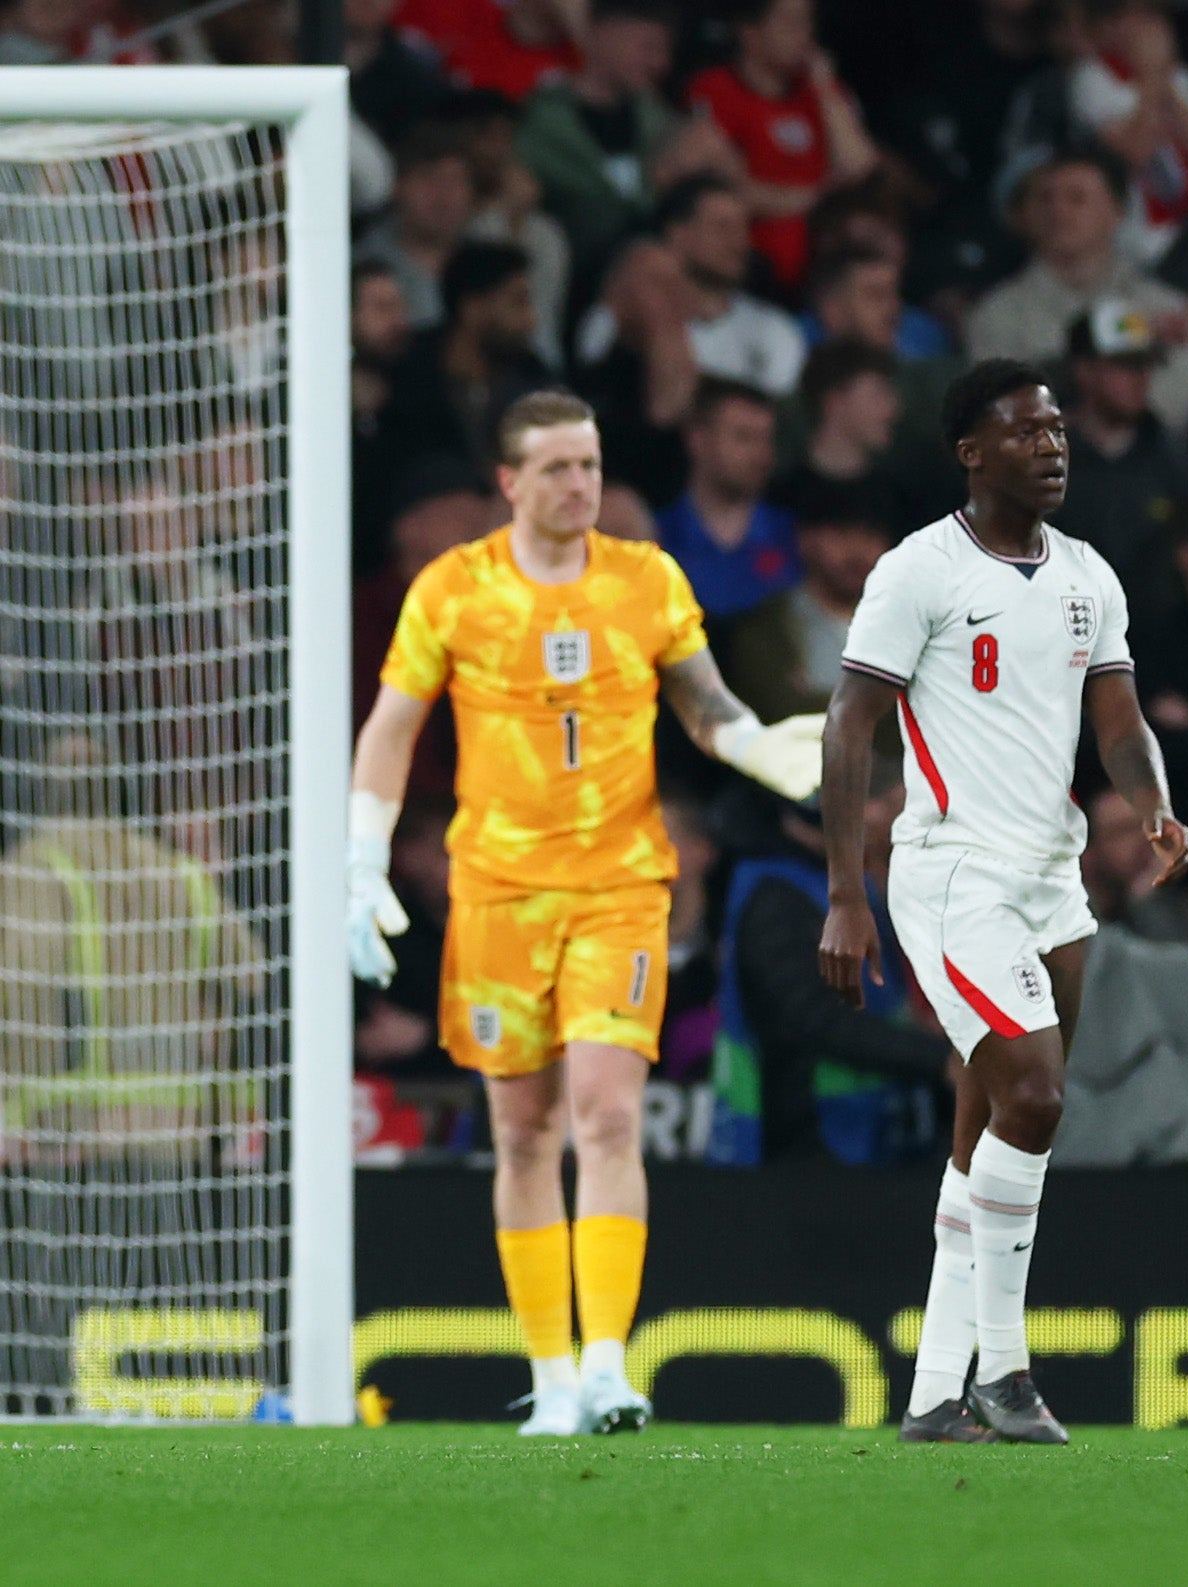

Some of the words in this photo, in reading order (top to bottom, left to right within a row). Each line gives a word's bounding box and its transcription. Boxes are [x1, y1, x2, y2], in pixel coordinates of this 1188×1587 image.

[972, 633, 999, 693] 8
[561, 711, 580, 771] 1
[629, 950, 649, 1007] 1
